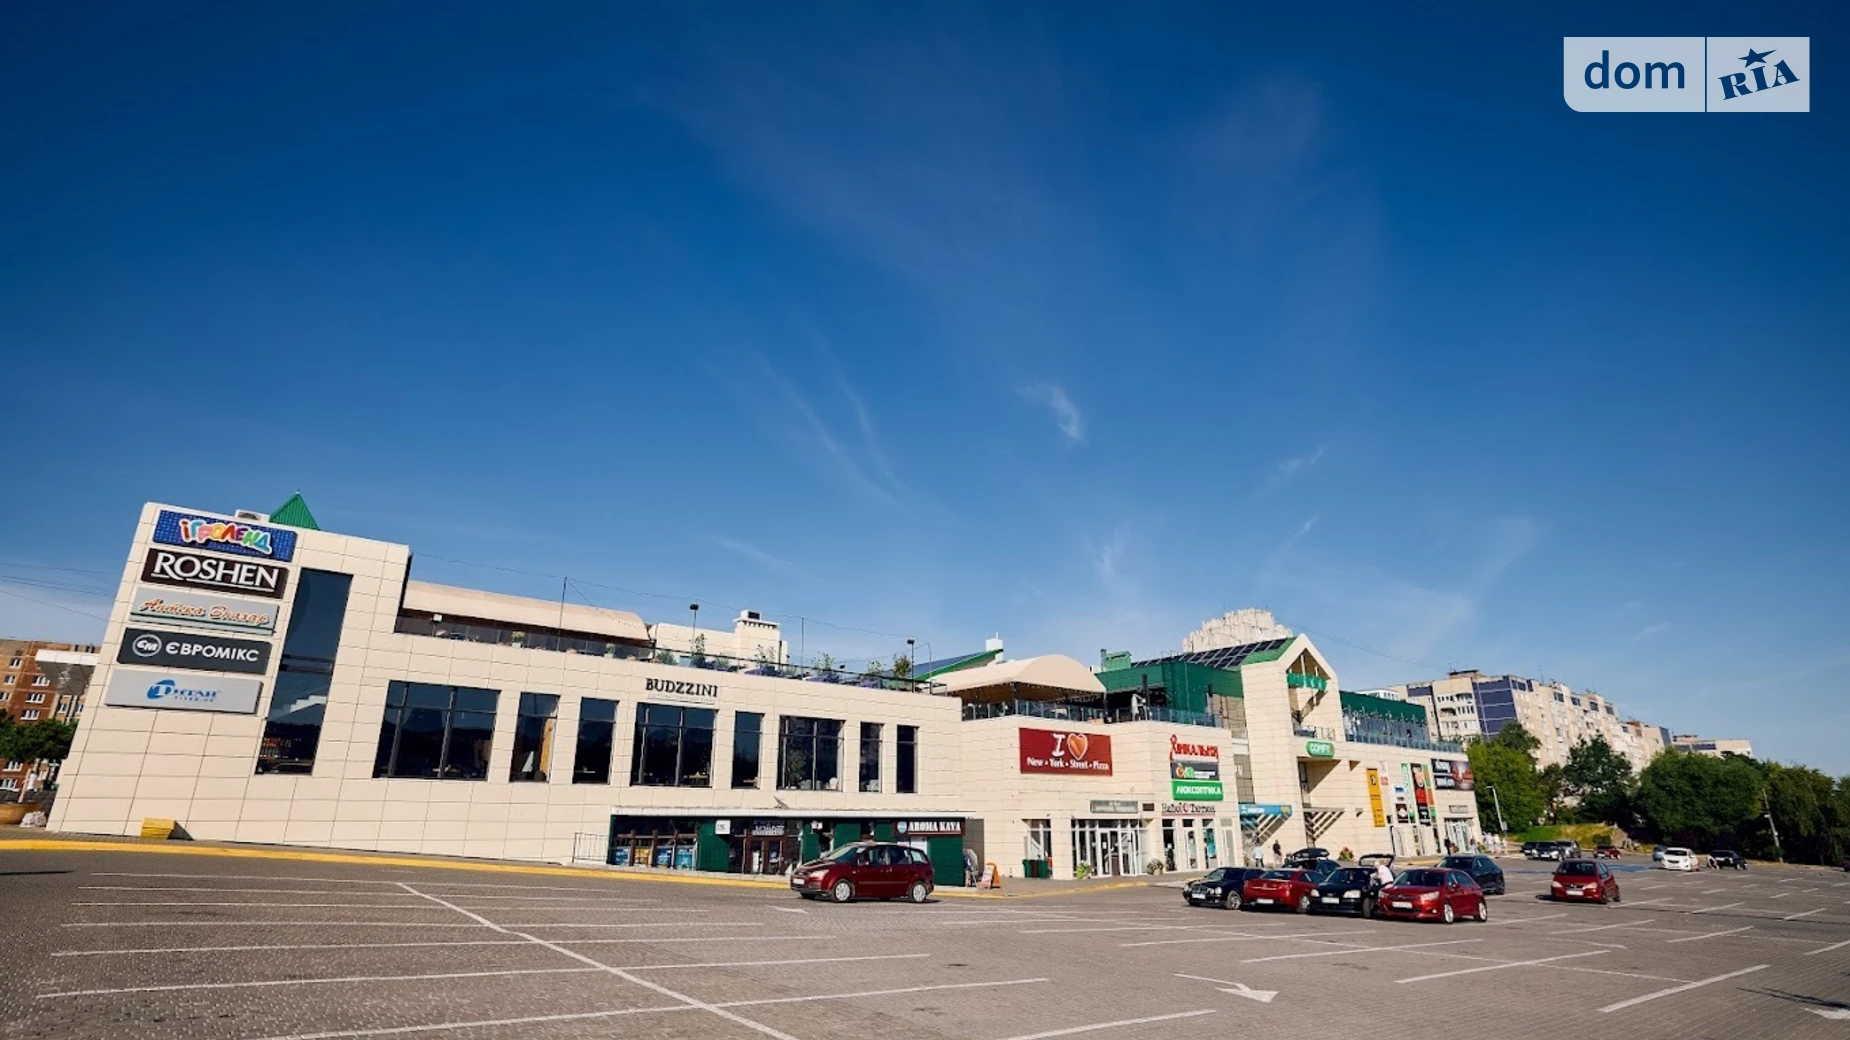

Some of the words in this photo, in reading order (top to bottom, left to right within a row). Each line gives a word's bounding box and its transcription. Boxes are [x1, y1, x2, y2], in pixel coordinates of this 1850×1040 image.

[152, 552, 279, 589] ROSHEN
[165, 641, 260, 662] ЄВРОМІКС
[645, 678, 718, 697] BUDZZINI
[1051, 733, 1066, 757] I
[1027, 757, 1043, 767] New
[1049, 758, 1064, 768] York
[1069, 759, 1088, 770] Street
[1092, 761, 1109, 770] Pizza
[907, 821, 938, 832] AROMA
